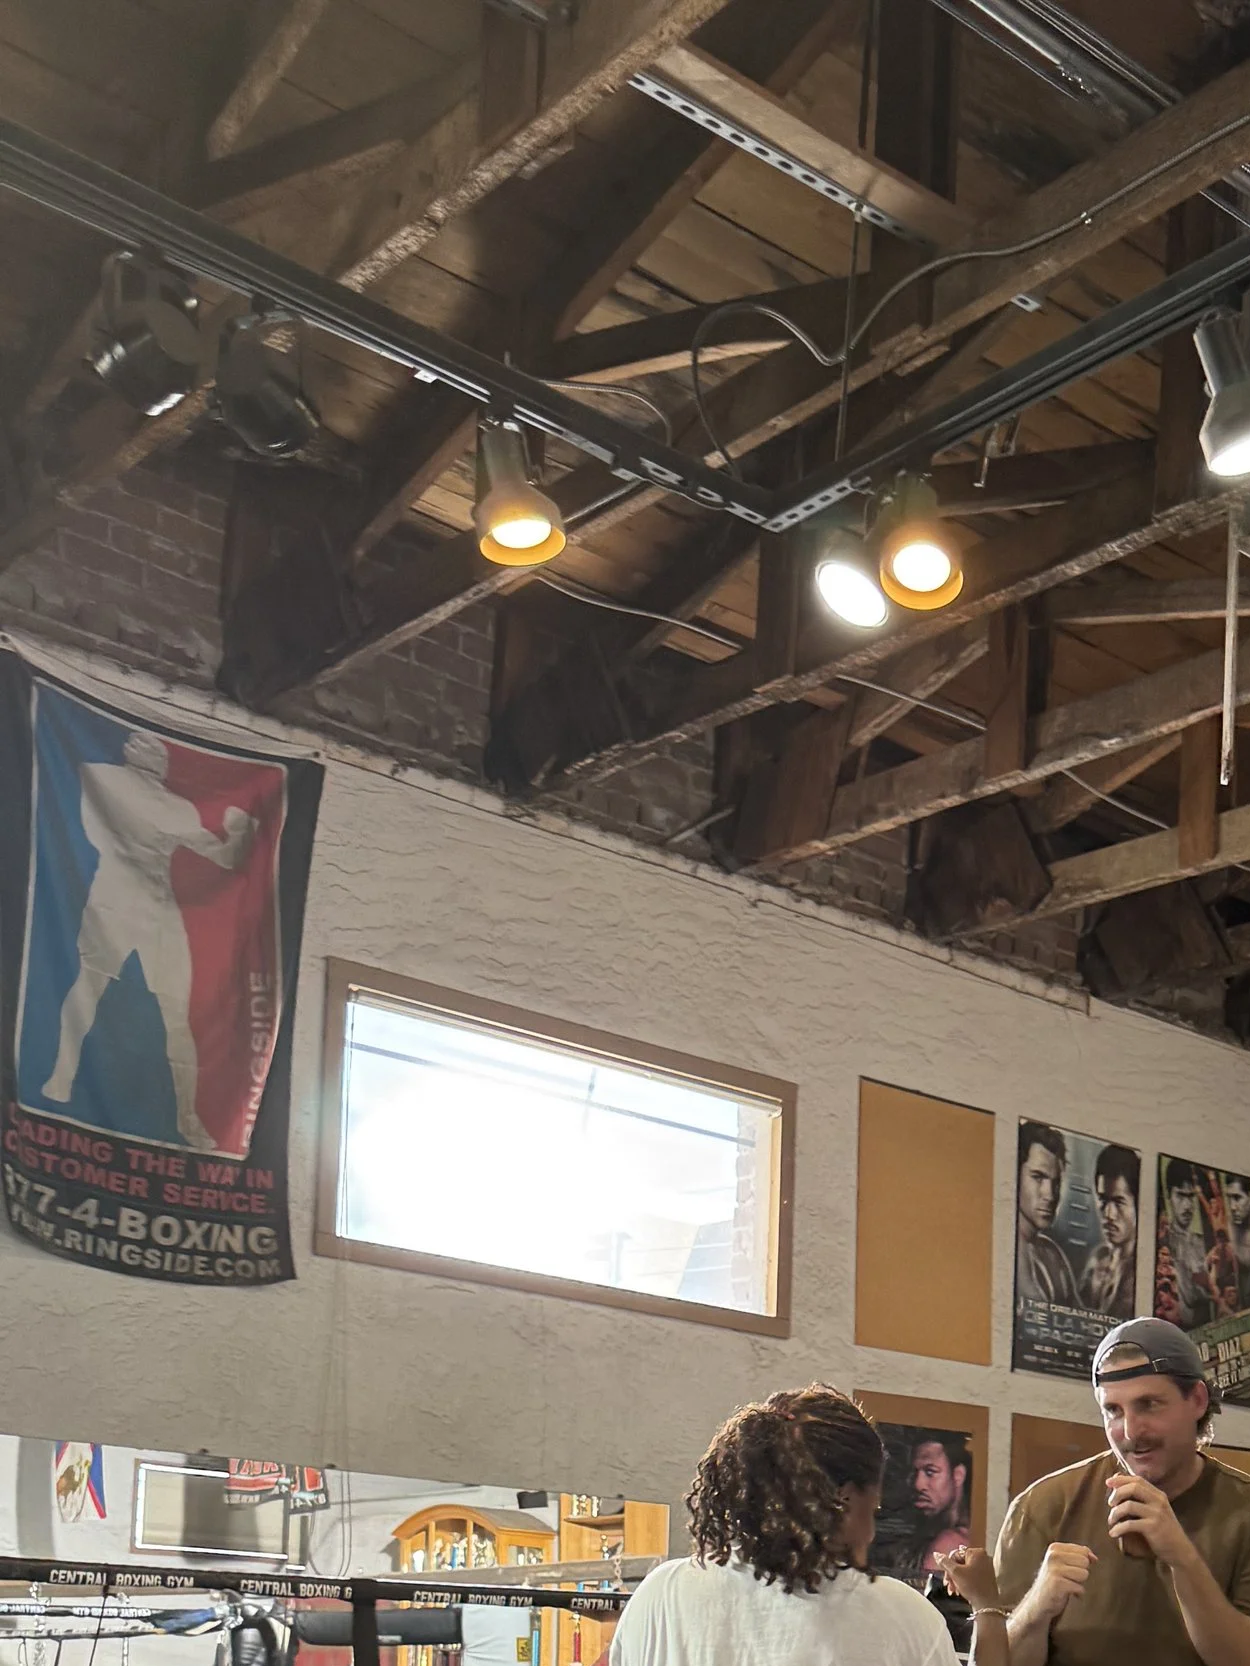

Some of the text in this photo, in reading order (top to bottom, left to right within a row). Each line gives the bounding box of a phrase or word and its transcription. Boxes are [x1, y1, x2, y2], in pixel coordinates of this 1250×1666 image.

[9, 1102, 273, 1189] LADING THE WA IN
[5, 1129, 148, 1198] CSTOMER
[1028, 1300, 1048, 1310] THE
[1050, 1304, 1088, 1316] DREAM
[1024, 1311, 1048, 1325] DE
[116, 1574, 161, 1587] BOXING
[167, 1576, 194, 1588] GYM
[240, 1580, 294, 1597] CENTRAL
[300, 1582, 341, 1598] BOXING
[571, 1597, 614, 1611] CENTRAL
